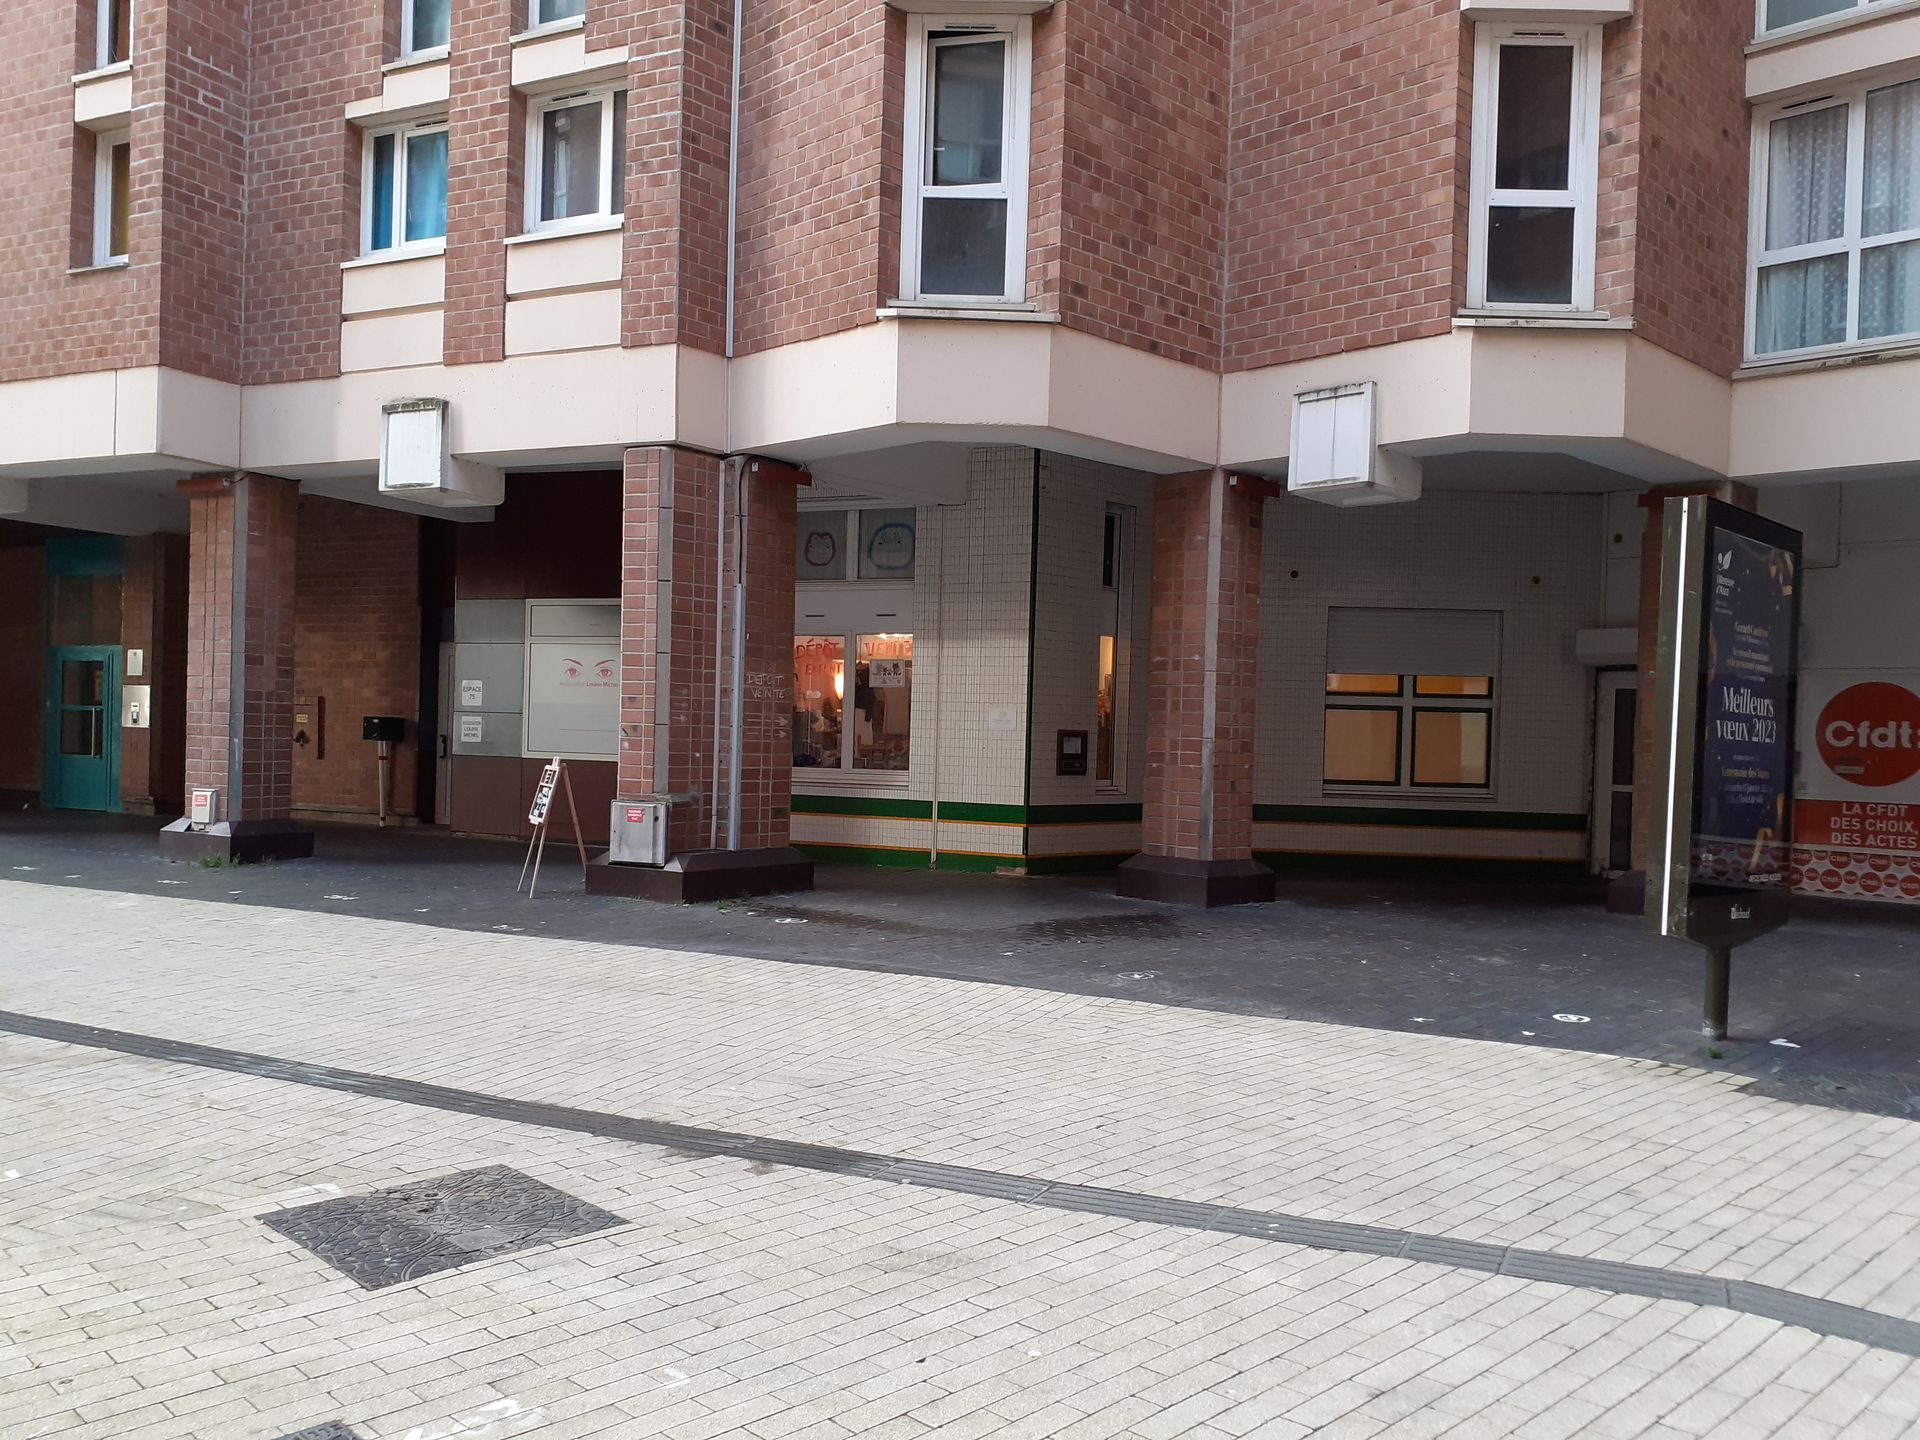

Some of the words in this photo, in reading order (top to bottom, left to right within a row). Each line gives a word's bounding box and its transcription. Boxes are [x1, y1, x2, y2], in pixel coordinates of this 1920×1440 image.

[864, 640, 911, 656] VENTE
[1722, 686, 1774, 718] Meilleurs
[1751, 719, 1777, 744] 2023
[1842, 802, 1861, 815] LA
[1866, 804, 1908, 817] CFDT
[1830, 816, 1861, 830] DES
[1831, 832, 1861, 846] DES
[1865, 835, 1918, 849] ACTES
